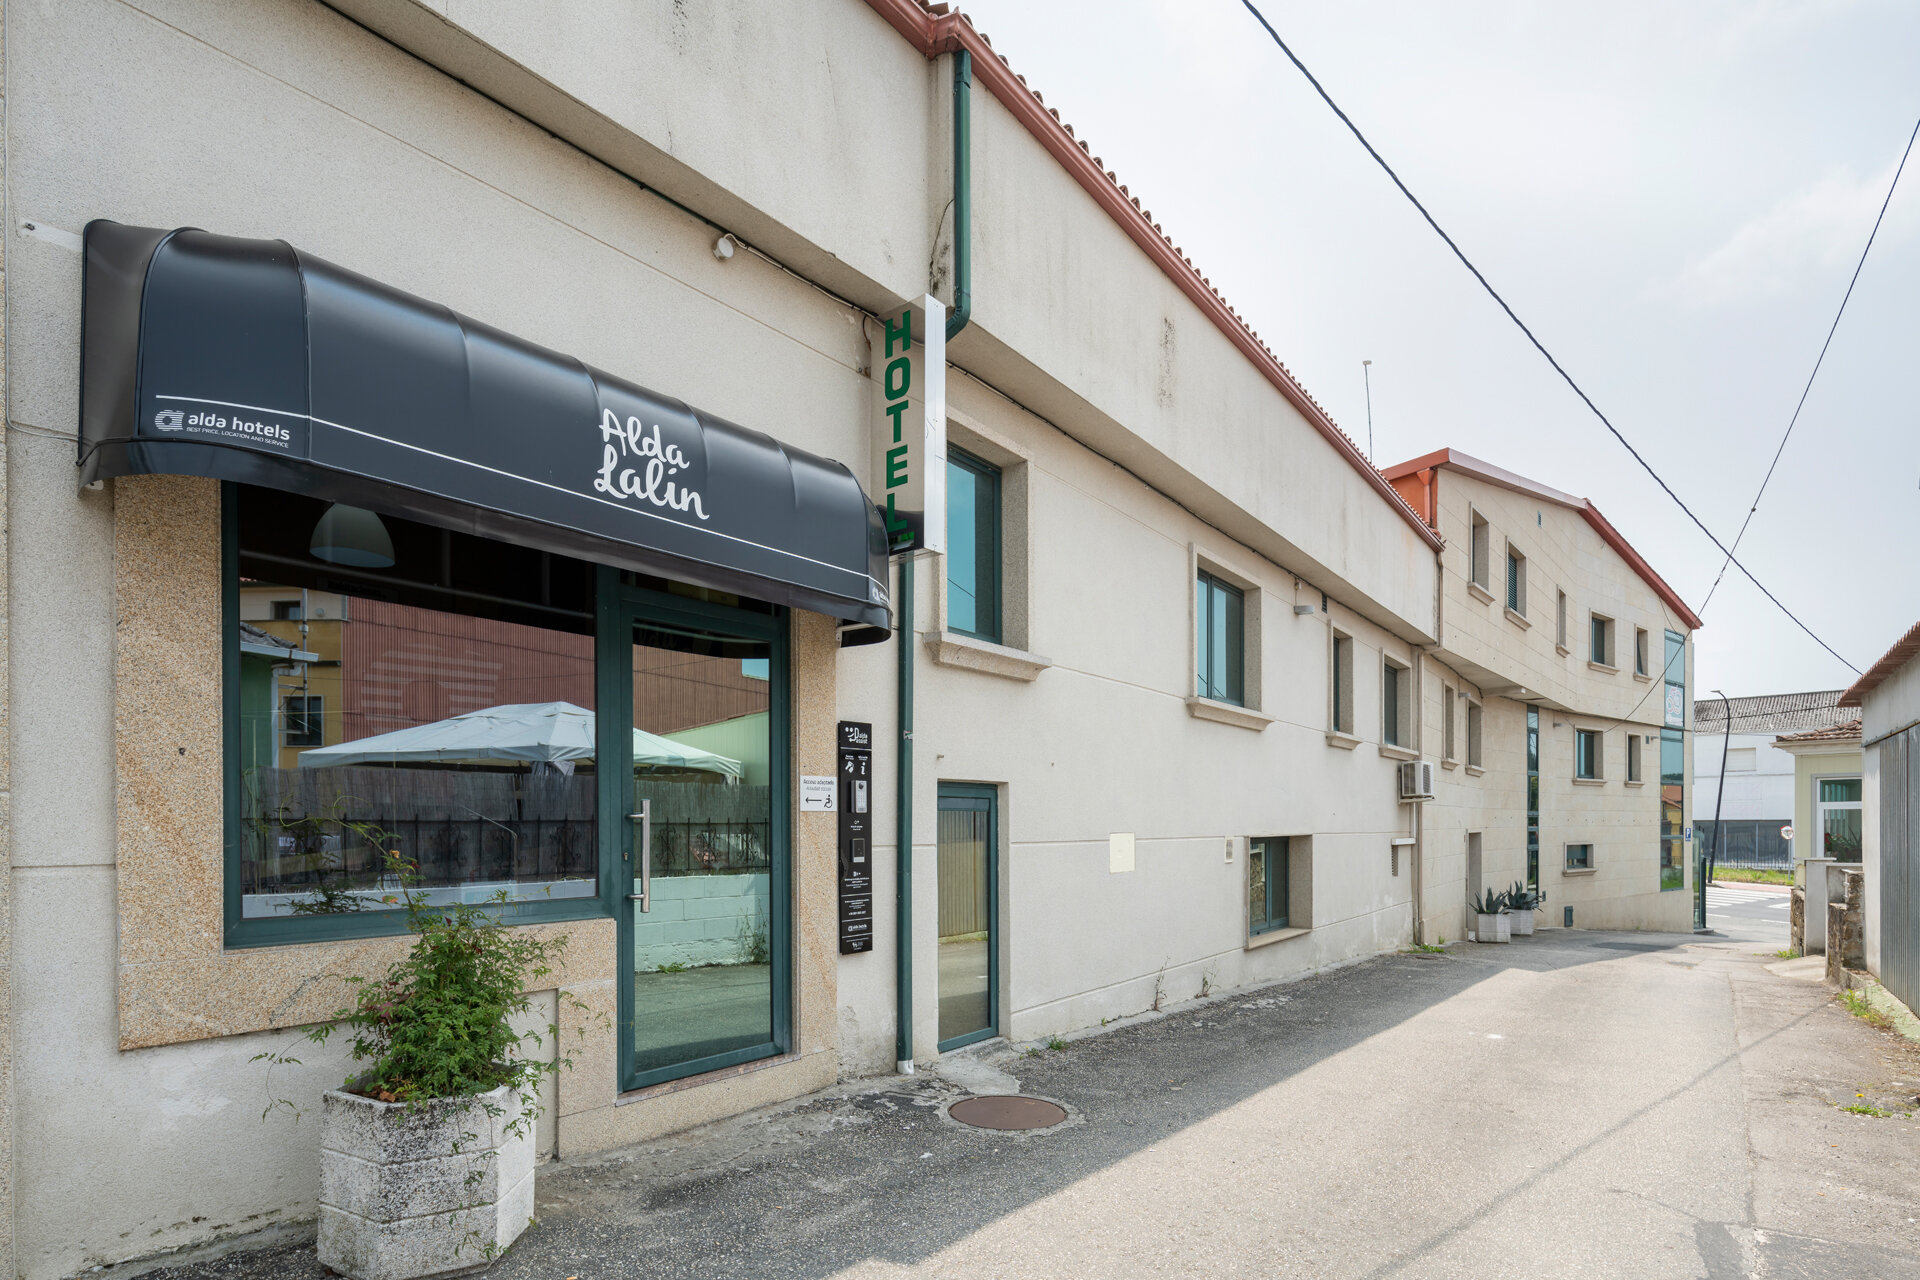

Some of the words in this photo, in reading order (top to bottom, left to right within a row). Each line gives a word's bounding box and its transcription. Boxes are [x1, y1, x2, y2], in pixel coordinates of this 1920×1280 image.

[188, 412, 227, 428] alda
[232, 416, 291, 441] hotels
[221, 430, 250, 440] LOCATION
[250, 435, 264, 443] AND
[264, 438, 289, 449] SERVICE
[598, 408, 690, 469] Alda
[885, 310, 911, 533] HOTEL
